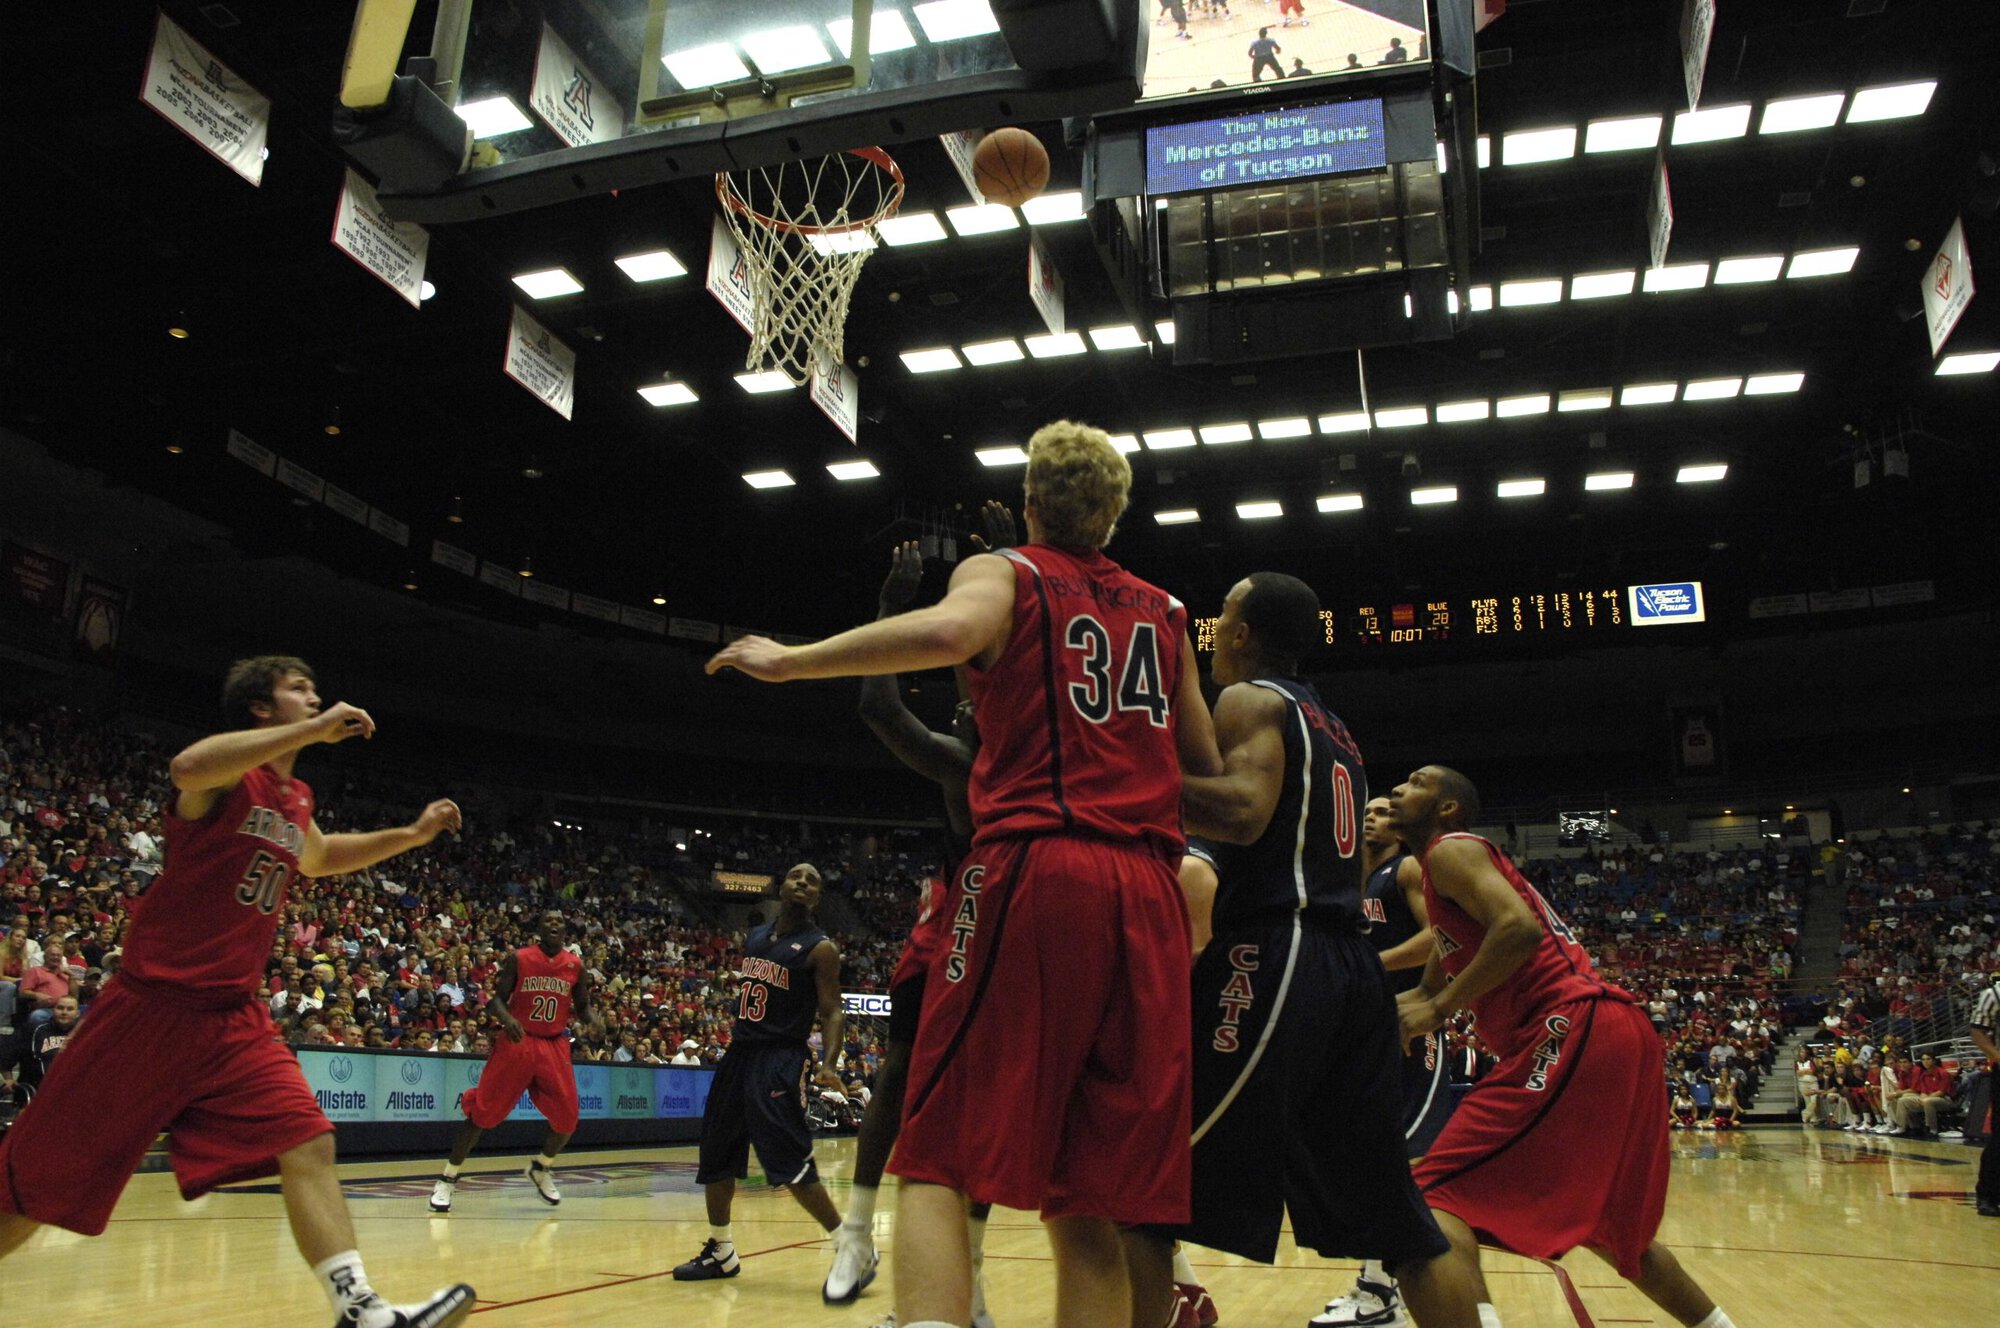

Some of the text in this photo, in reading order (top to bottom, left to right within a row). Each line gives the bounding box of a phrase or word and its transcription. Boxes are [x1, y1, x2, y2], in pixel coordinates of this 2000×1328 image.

[155, 84, 178, 108] 2005
[183, 106, 204, 129] 2006
[169, 74, 248, 136] NCAA TOURNAMENT
[171, 87, 193, 110] 2002
[197, 108, 218, 129] 2003
[1222, 114, 1308, 136] The New
[1165, 126, 1369, 164] Mercedes-Benz
[1200, 152, 1333, 182] of Tucson
[353, 217, 413, 266] NCAA TOURNAMENT
[1472, 598, 1498, 609] PLYR
[1512, 596, 1521, 606] 0
[1578, 591, 1594, 600] 14
[1602, 589, 1618, 599] 44
[1649, 588, 1683, 597] Tucson
[1654, 594, 1691, 604] Electric
[1359, 607, 1375, 616] RED
[1427, 602, 1448, 611] BLUE
[1476, 607, 1495, 617] PTS
[1658, 603, 1691, 612] Power
[1325, 620, 1333, 628] 0
[1366, 617, 1378, 630] 13
[1432, 612, 1449, 625] 28
[1476, 616, 1497, 626] RBS
[1325, 628, 1334, 636] 0
[1391, 628, 1422, 643] 10:07
[1476, 625, 1498, 634] FLS
[1326, 636, 1334, 644] 0
[1065, 613, 1170, 729] 34
[1332, 759, 1357, 859] 0
[235, 850, 289, 915] 50
[946, 864, 986, 983] CATS
[738, 981, 768, 1022] 13
[1213, 944, 1260, 1053] CATS
[529, 995, 558, 1023] 20
[1525, 1014, 1570, 1091] CATS
[315, 1089, 366, 1110] Allstate
[385, 1091, 434, 1110] Allstate
[617, 1094, 648, 1110] Allstate
[662, 1095, 690, 1109] Allstate
